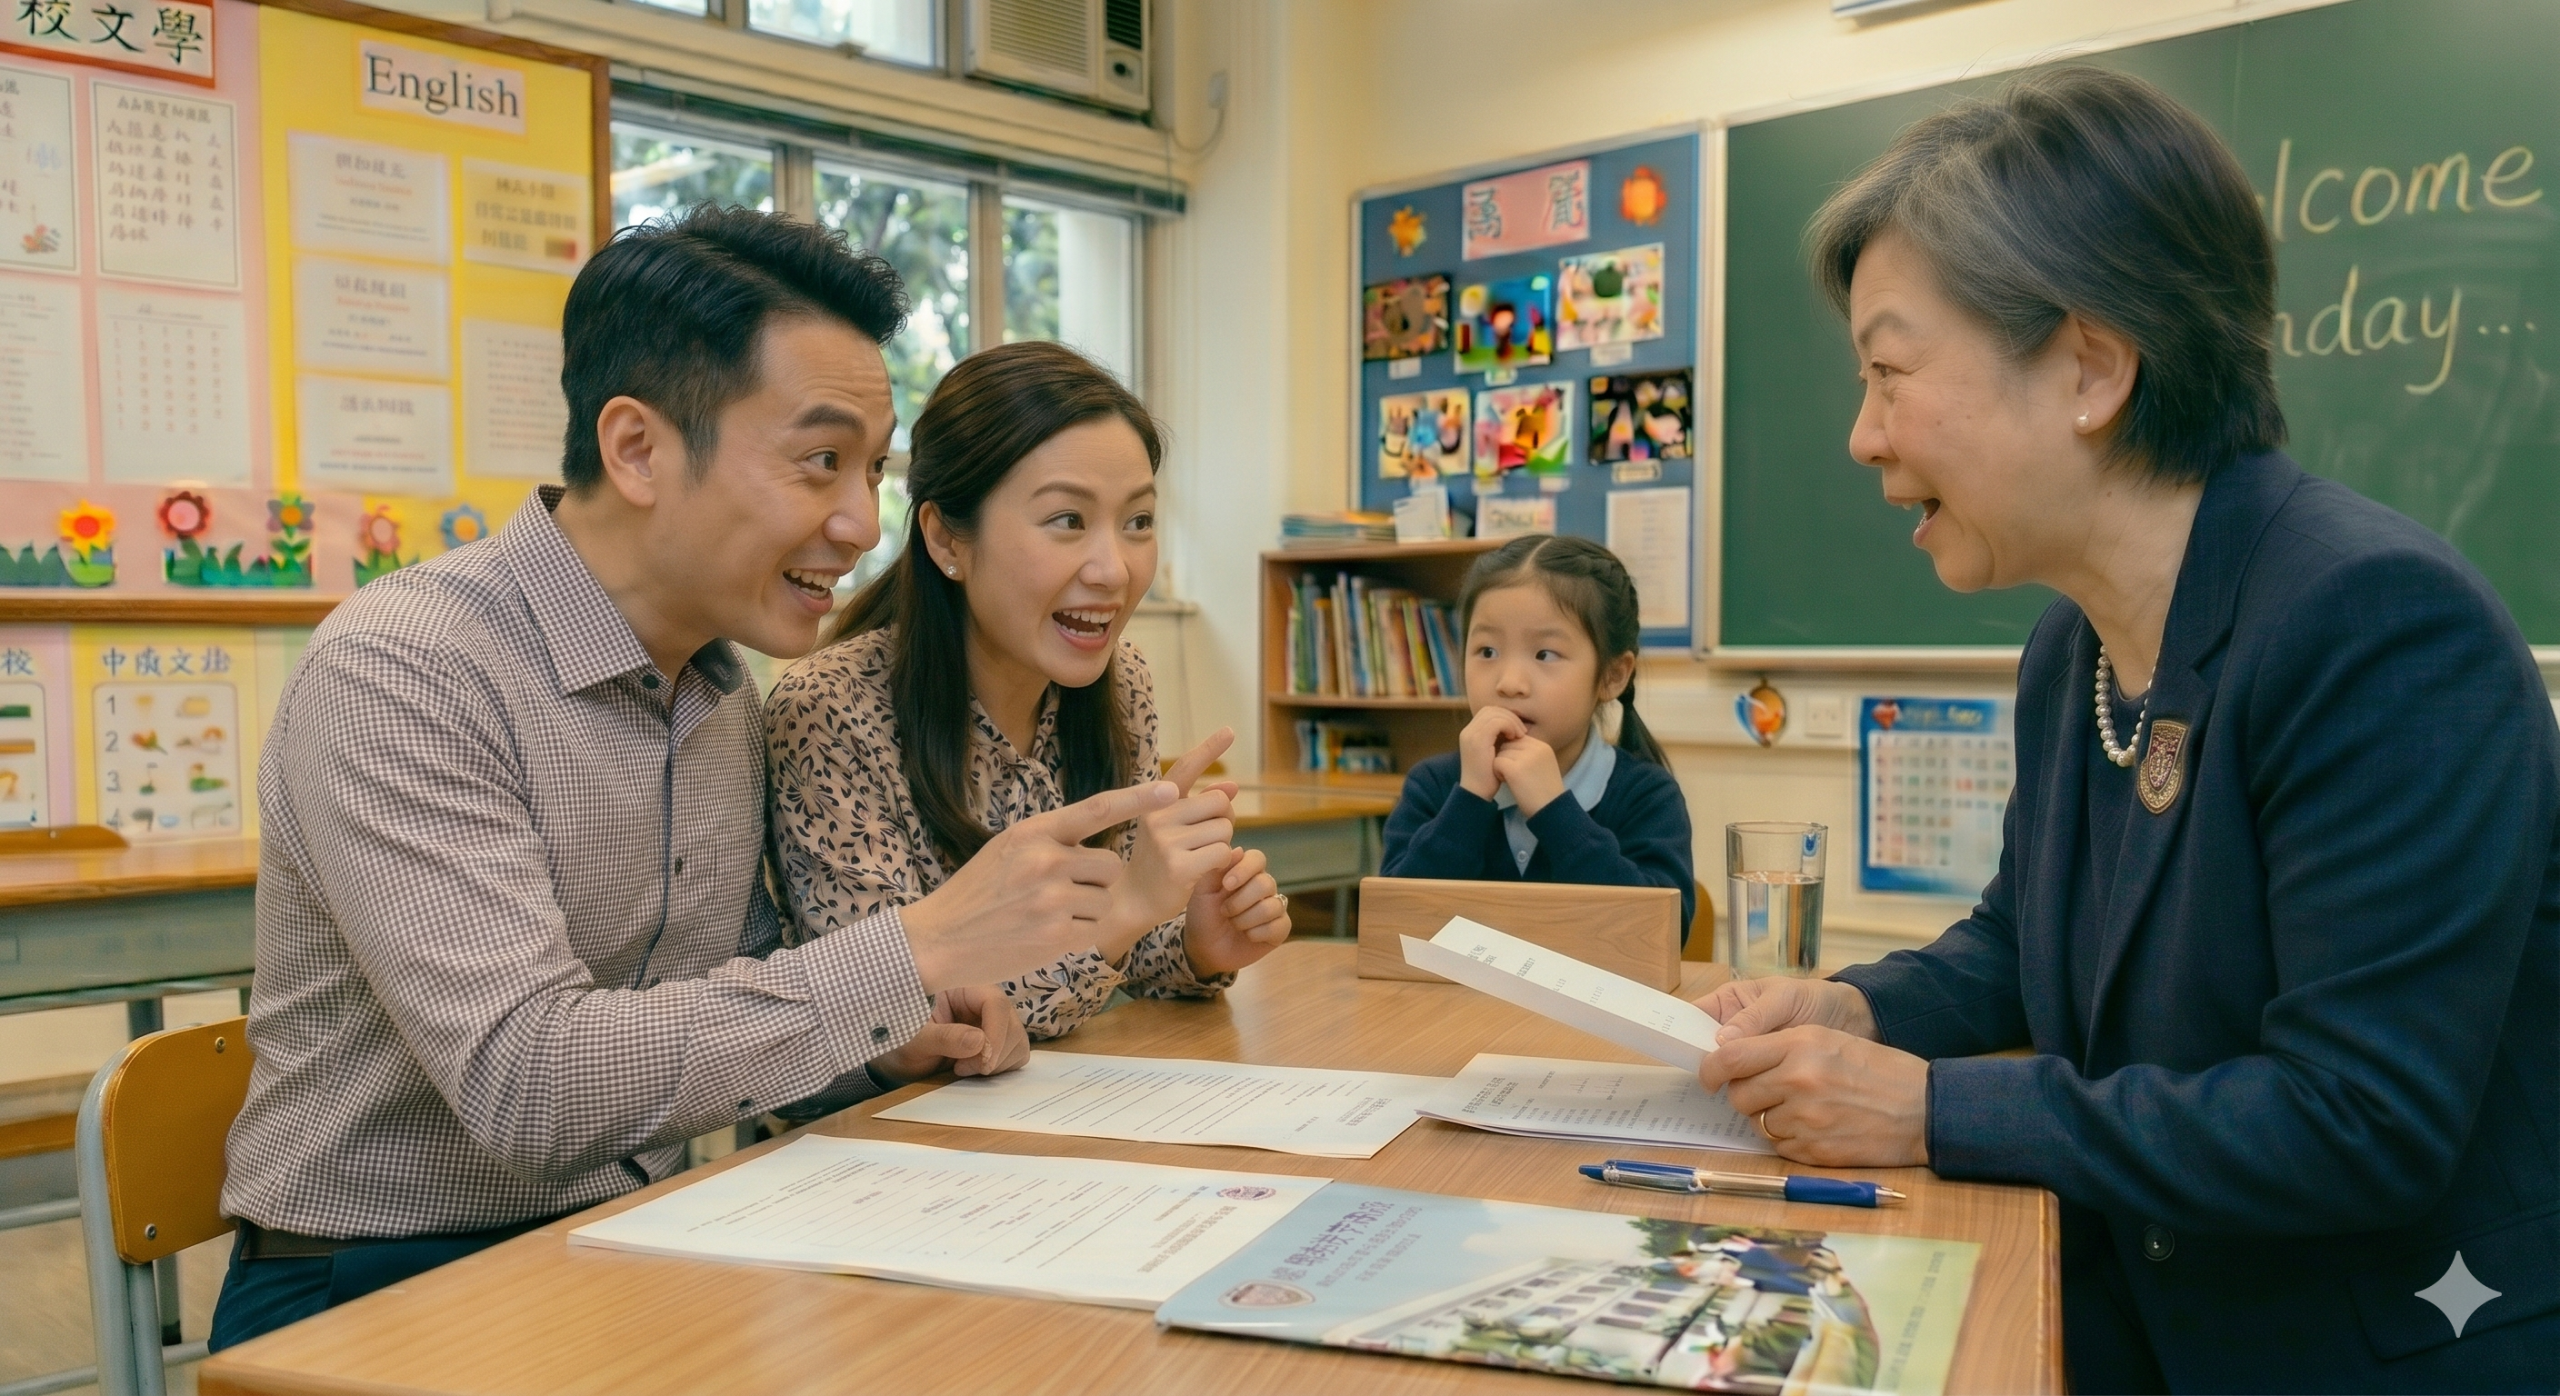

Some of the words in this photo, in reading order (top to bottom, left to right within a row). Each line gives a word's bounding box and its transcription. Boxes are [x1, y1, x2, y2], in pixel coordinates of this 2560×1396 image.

[365, 51, 520, 119] English
[2256, 138, 2544, 242] lcome
[107, 695, 116, 715] 1
[105, 731, 119, 752] 2
[106, 770, 120, 793] 3
